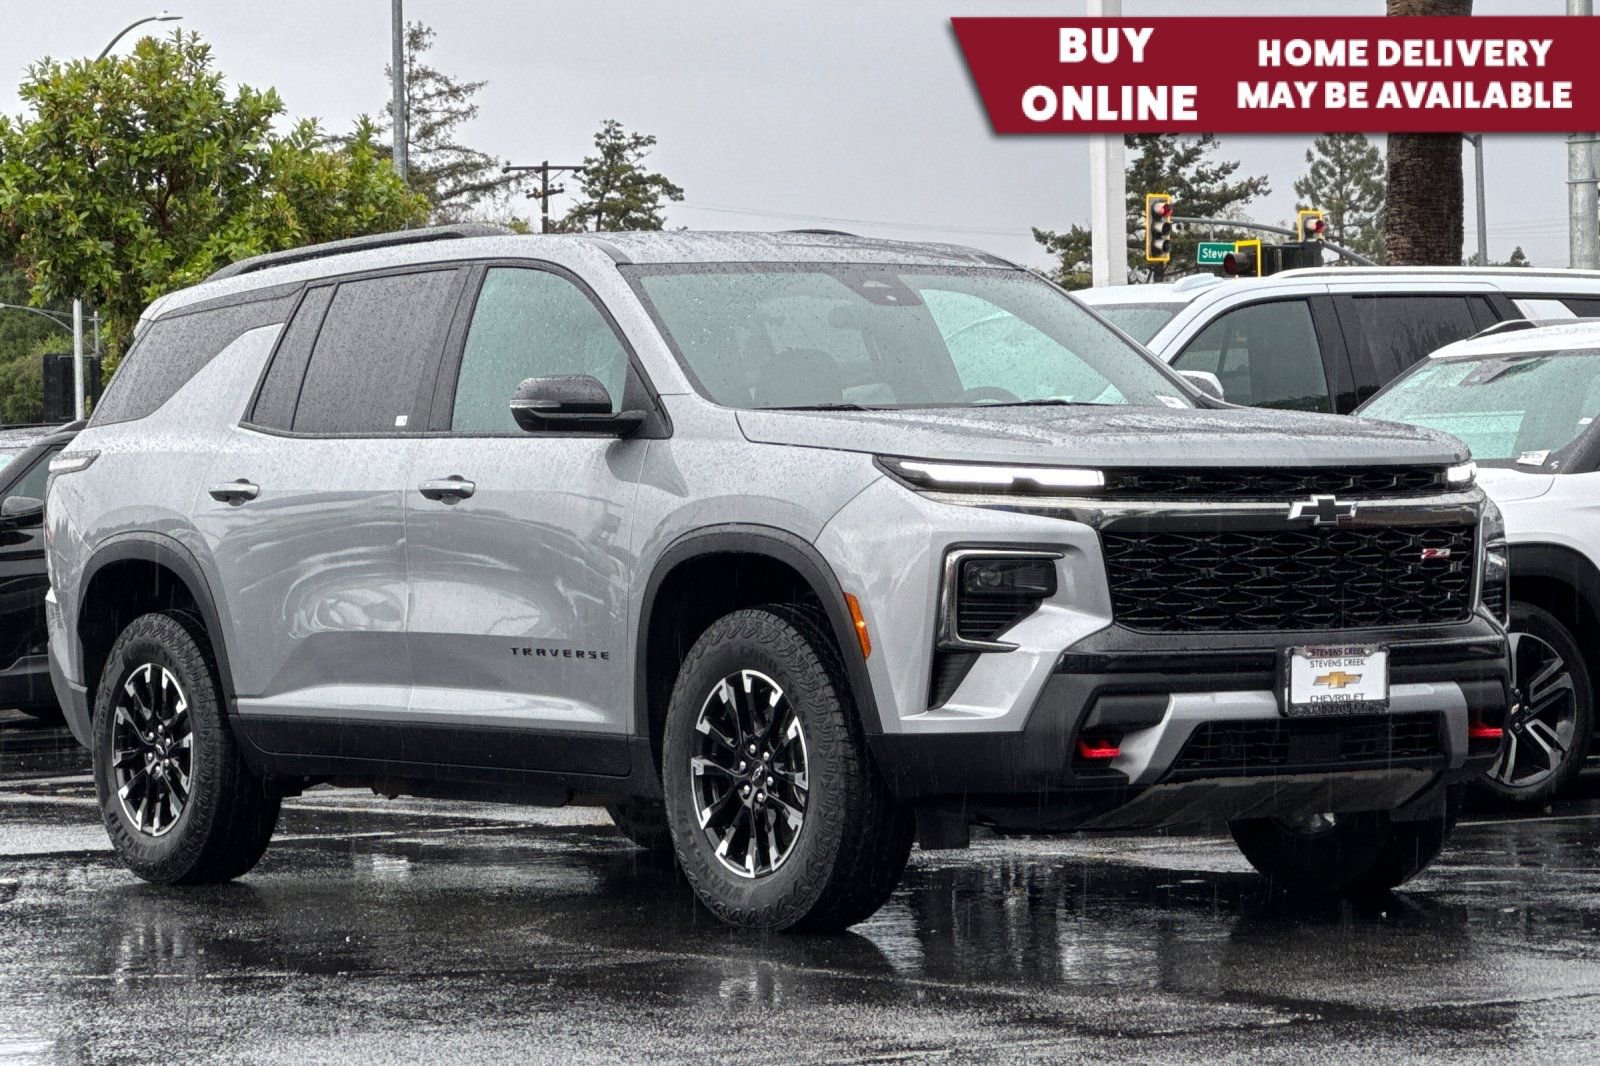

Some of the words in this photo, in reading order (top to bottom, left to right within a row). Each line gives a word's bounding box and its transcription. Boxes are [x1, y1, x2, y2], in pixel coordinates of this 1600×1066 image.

[510, 647, 610, 660] TRAVERSE
[1310, 648, 1343, 657] STEVENS
[1344, 647, 1366, 656] CREEK
[1310, 660, 1342, 668] STEVENS
[1343, 658, 1365, 667] CREEK
[1310, 693, 1365, 703] CHEVROLET
